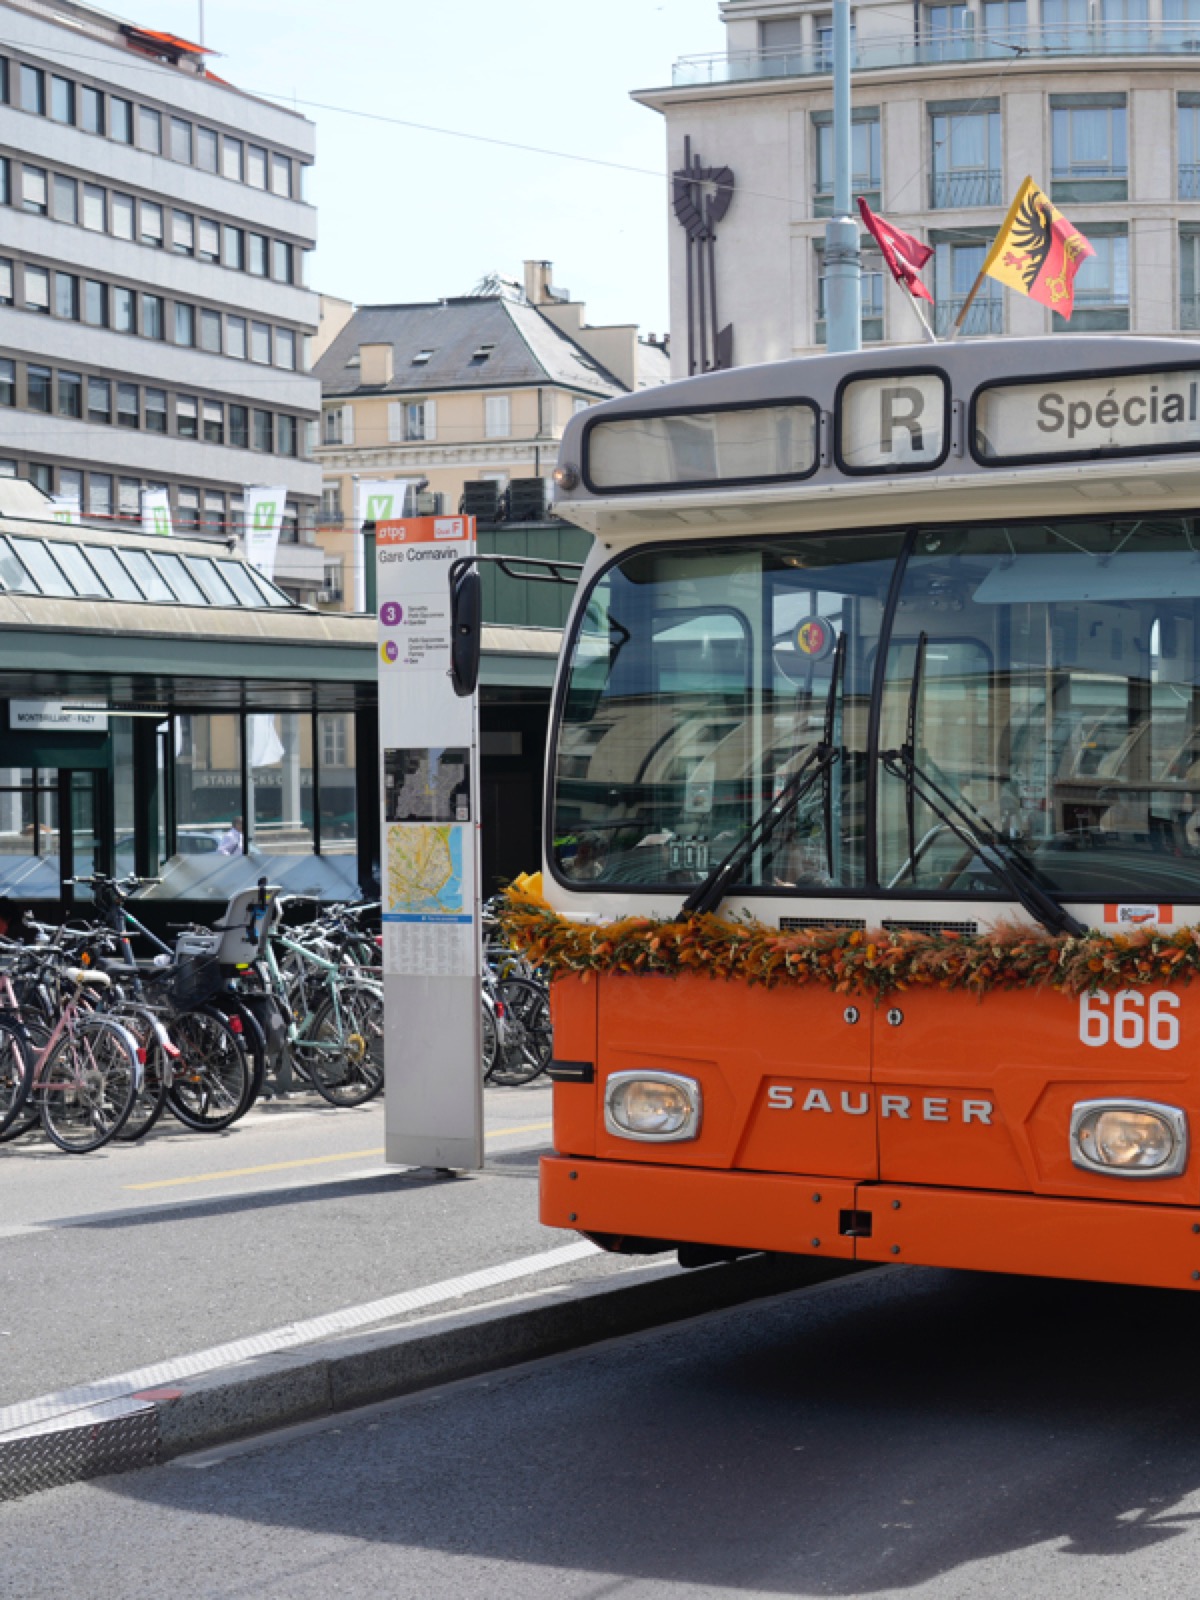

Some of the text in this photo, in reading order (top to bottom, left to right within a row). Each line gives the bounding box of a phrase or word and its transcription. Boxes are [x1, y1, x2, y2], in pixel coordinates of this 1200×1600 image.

[880, 386, 924, 452] R
[1037, 382, 1197, 439] Spécial
[387, 526, 405, 540] tpg
[451, 521, 460, 535] F
[379, 545, 459, 564] Gare Cornavin
[386, 606, 396, 621] 3
[1080, 988, 1180, 1050] 666
[767, 1085, 993, 1125] SAURER
